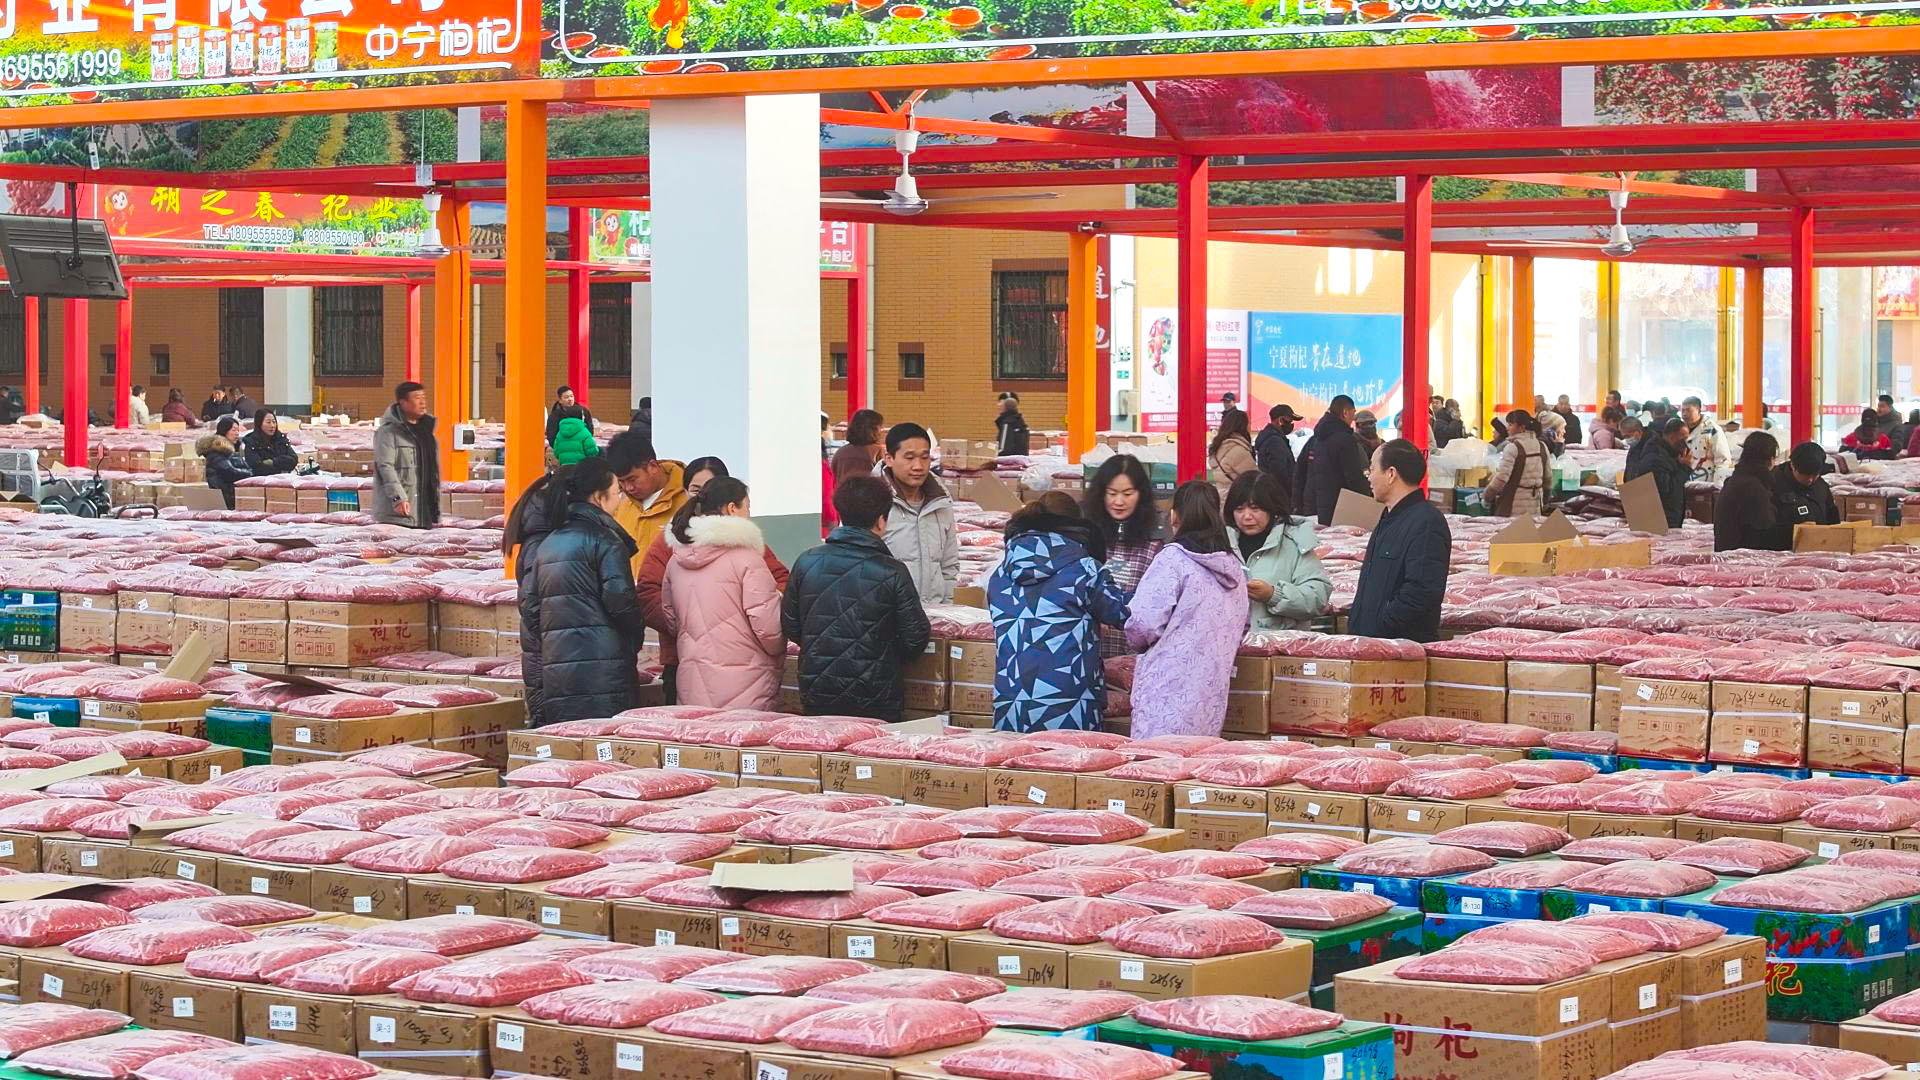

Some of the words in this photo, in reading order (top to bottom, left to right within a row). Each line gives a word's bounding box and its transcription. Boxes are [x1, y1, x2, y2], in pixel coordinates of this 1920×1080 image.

[366, 17, 511, 60] 中宁枸杞
[370, 617, 411, 642] 枸杞
[1369, 678, 1407, 706] 枸杞
[459, 722, 505, 751] 枸杞
[1325, 801, 1344, 822] 47
[1425, 806, 1447, 830] 49
[1384, 1012, 1478, 1061] 枸杞
